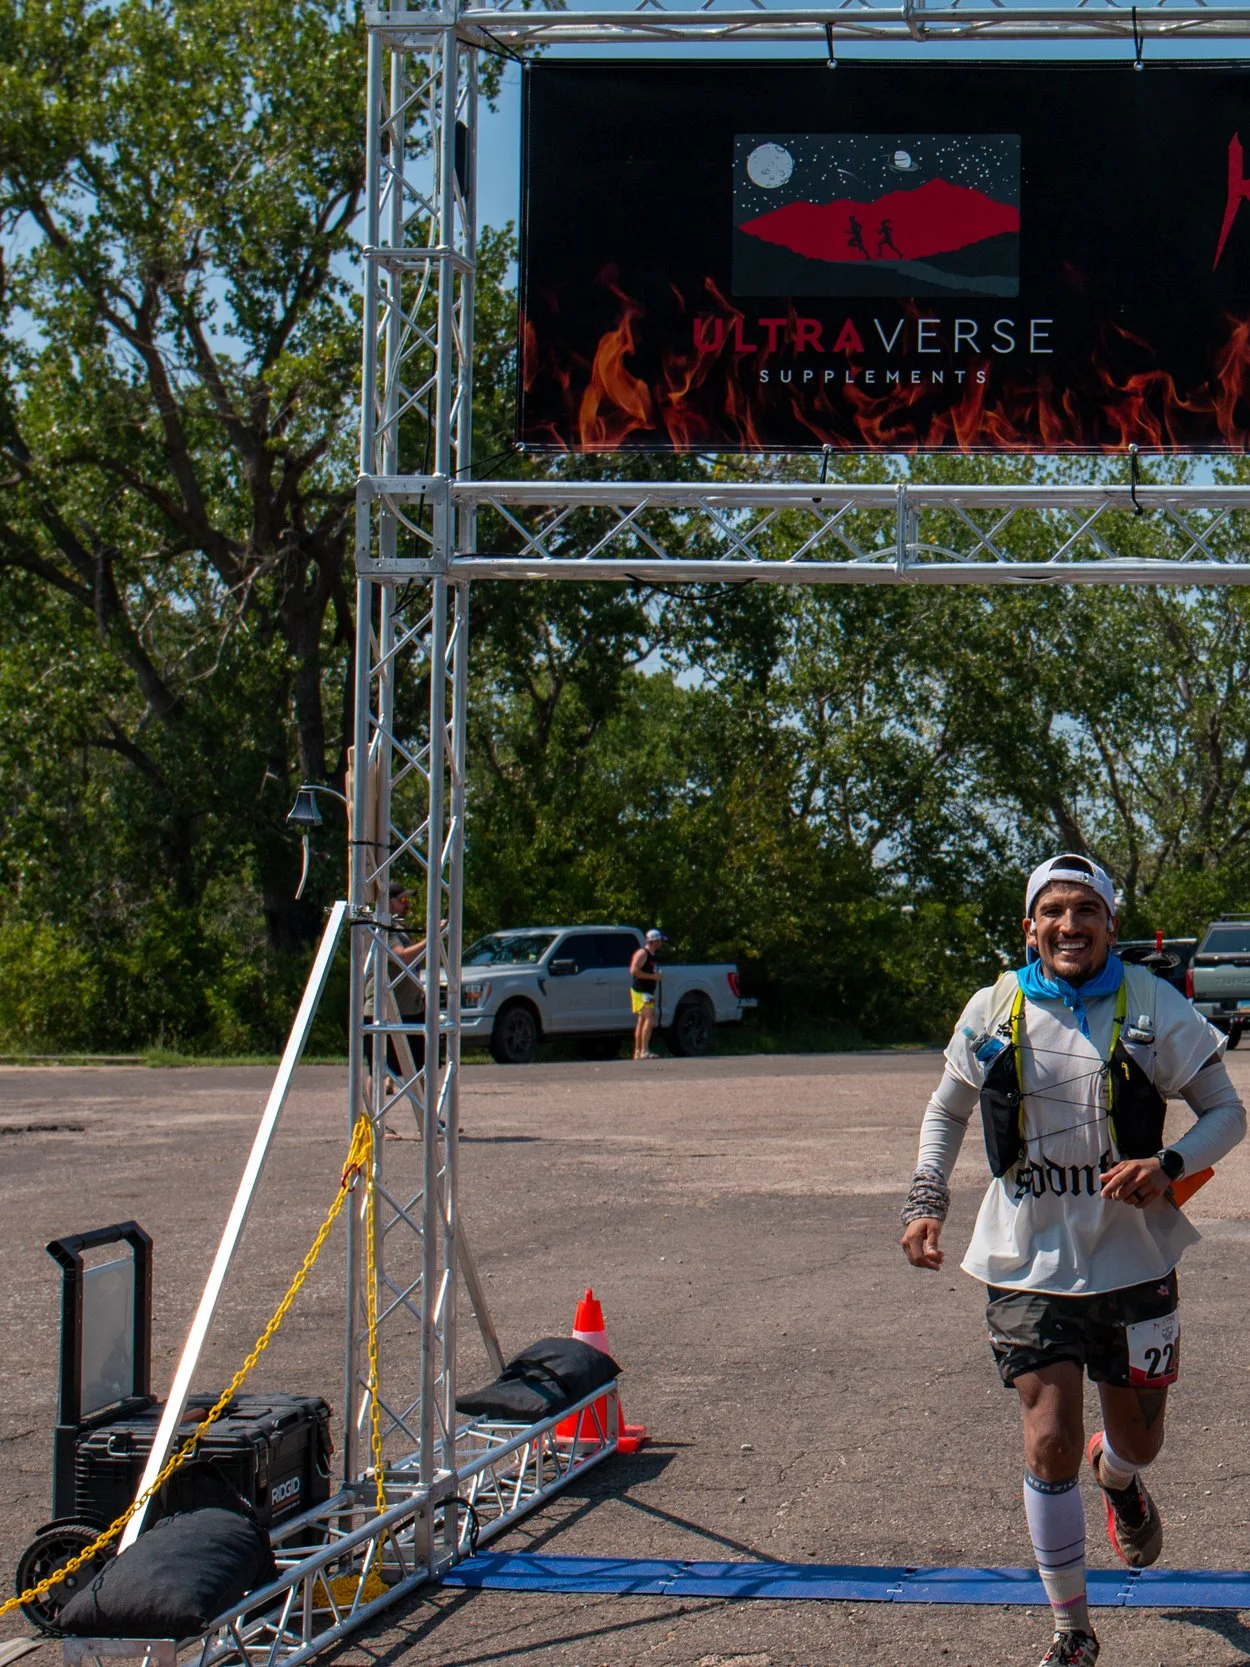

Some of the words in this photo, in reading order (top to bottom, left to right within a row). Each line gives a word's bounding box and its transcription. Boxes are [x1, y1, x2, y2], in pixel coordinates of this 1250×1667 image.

[693, 317, 1055, 354] ULTRAVERSE
[758, 369, 989, 385] SUPPLEMENTS
[271, 1476, 301, 1506] RIDGID
